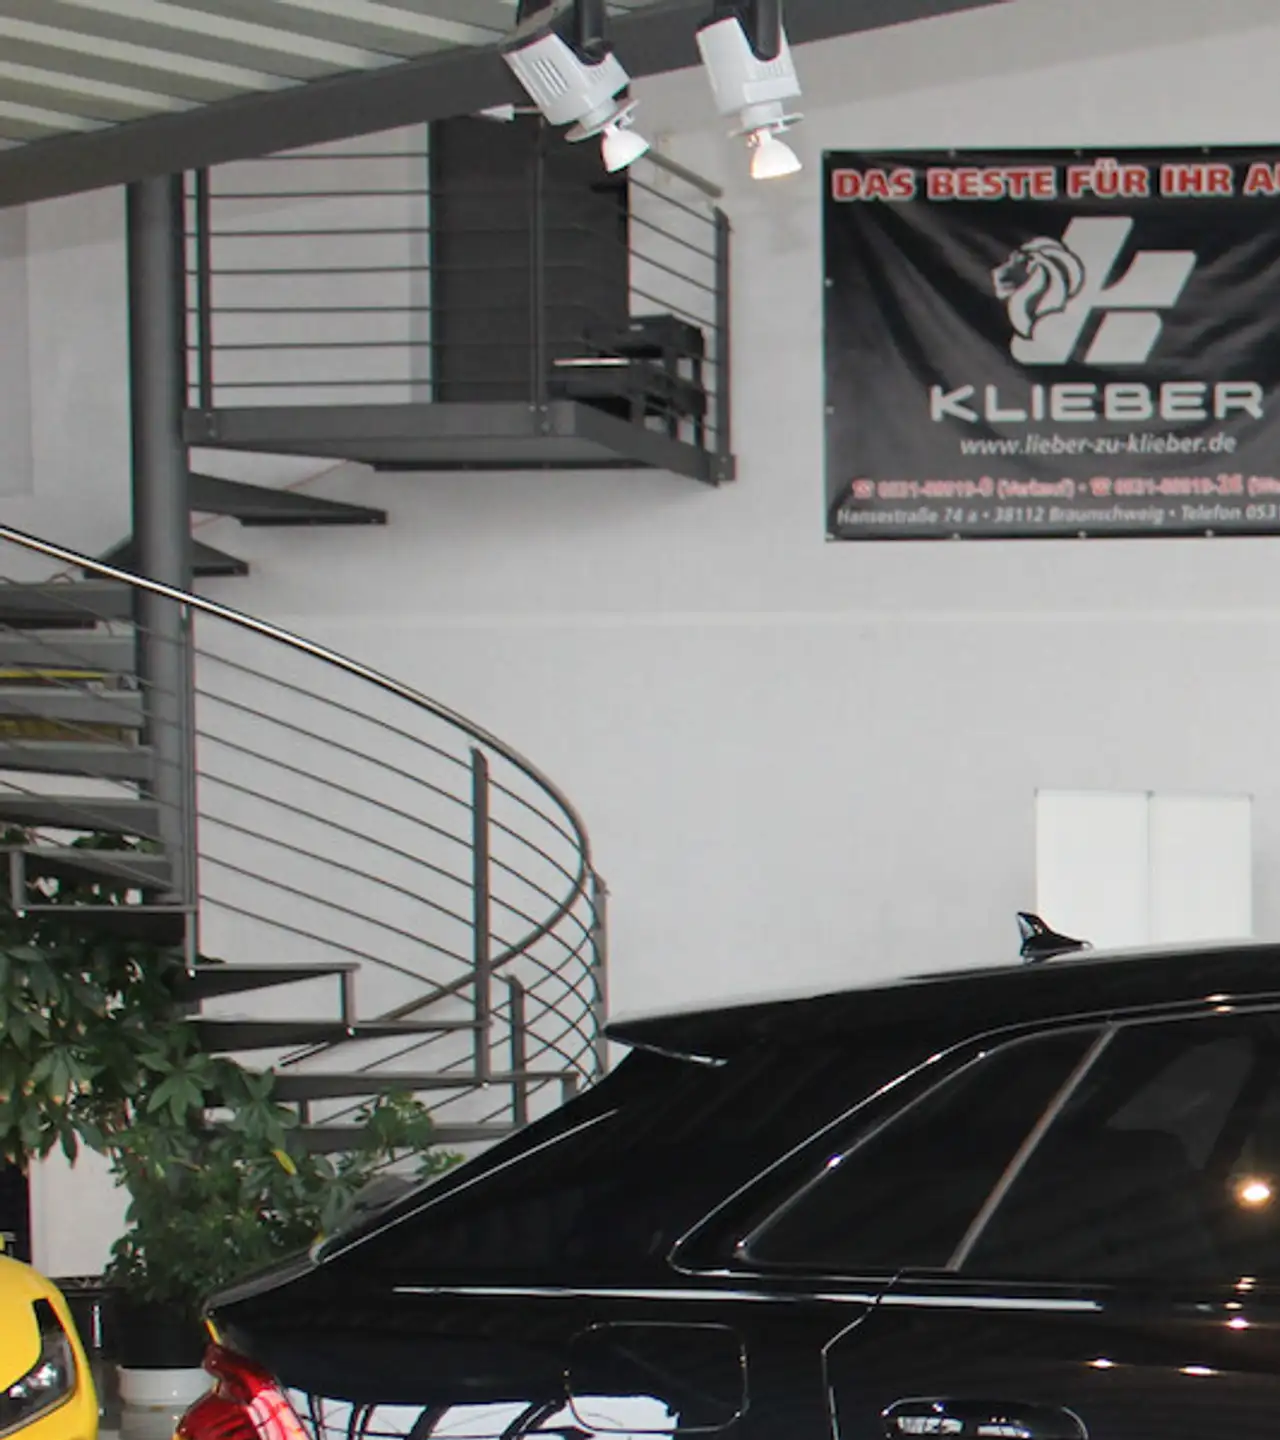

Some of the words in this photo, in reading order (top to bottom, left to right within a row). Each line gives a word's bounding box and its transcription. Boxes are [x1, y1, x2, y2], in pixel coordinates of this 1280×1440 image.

[832, 168, 914, 200] DAS
[927, 166, 1055, 199] BESTE
[1066, 159, 1149, 198] FÜR
[1159, 163, 1232, 196] IHR
[930, 381, 1264, 422] KLIEBER
[960, 432, 1237, 456] www.lieber-zu-klieber.de
[837, 507, 939, 525] Hansestraße
[941, 507, 964, 523] 74
[993, 506, 1045, 523] 38112
[1049, 504, 1164, 526] Braunschweig
[1181, 504, 1242, 522] Telefon
